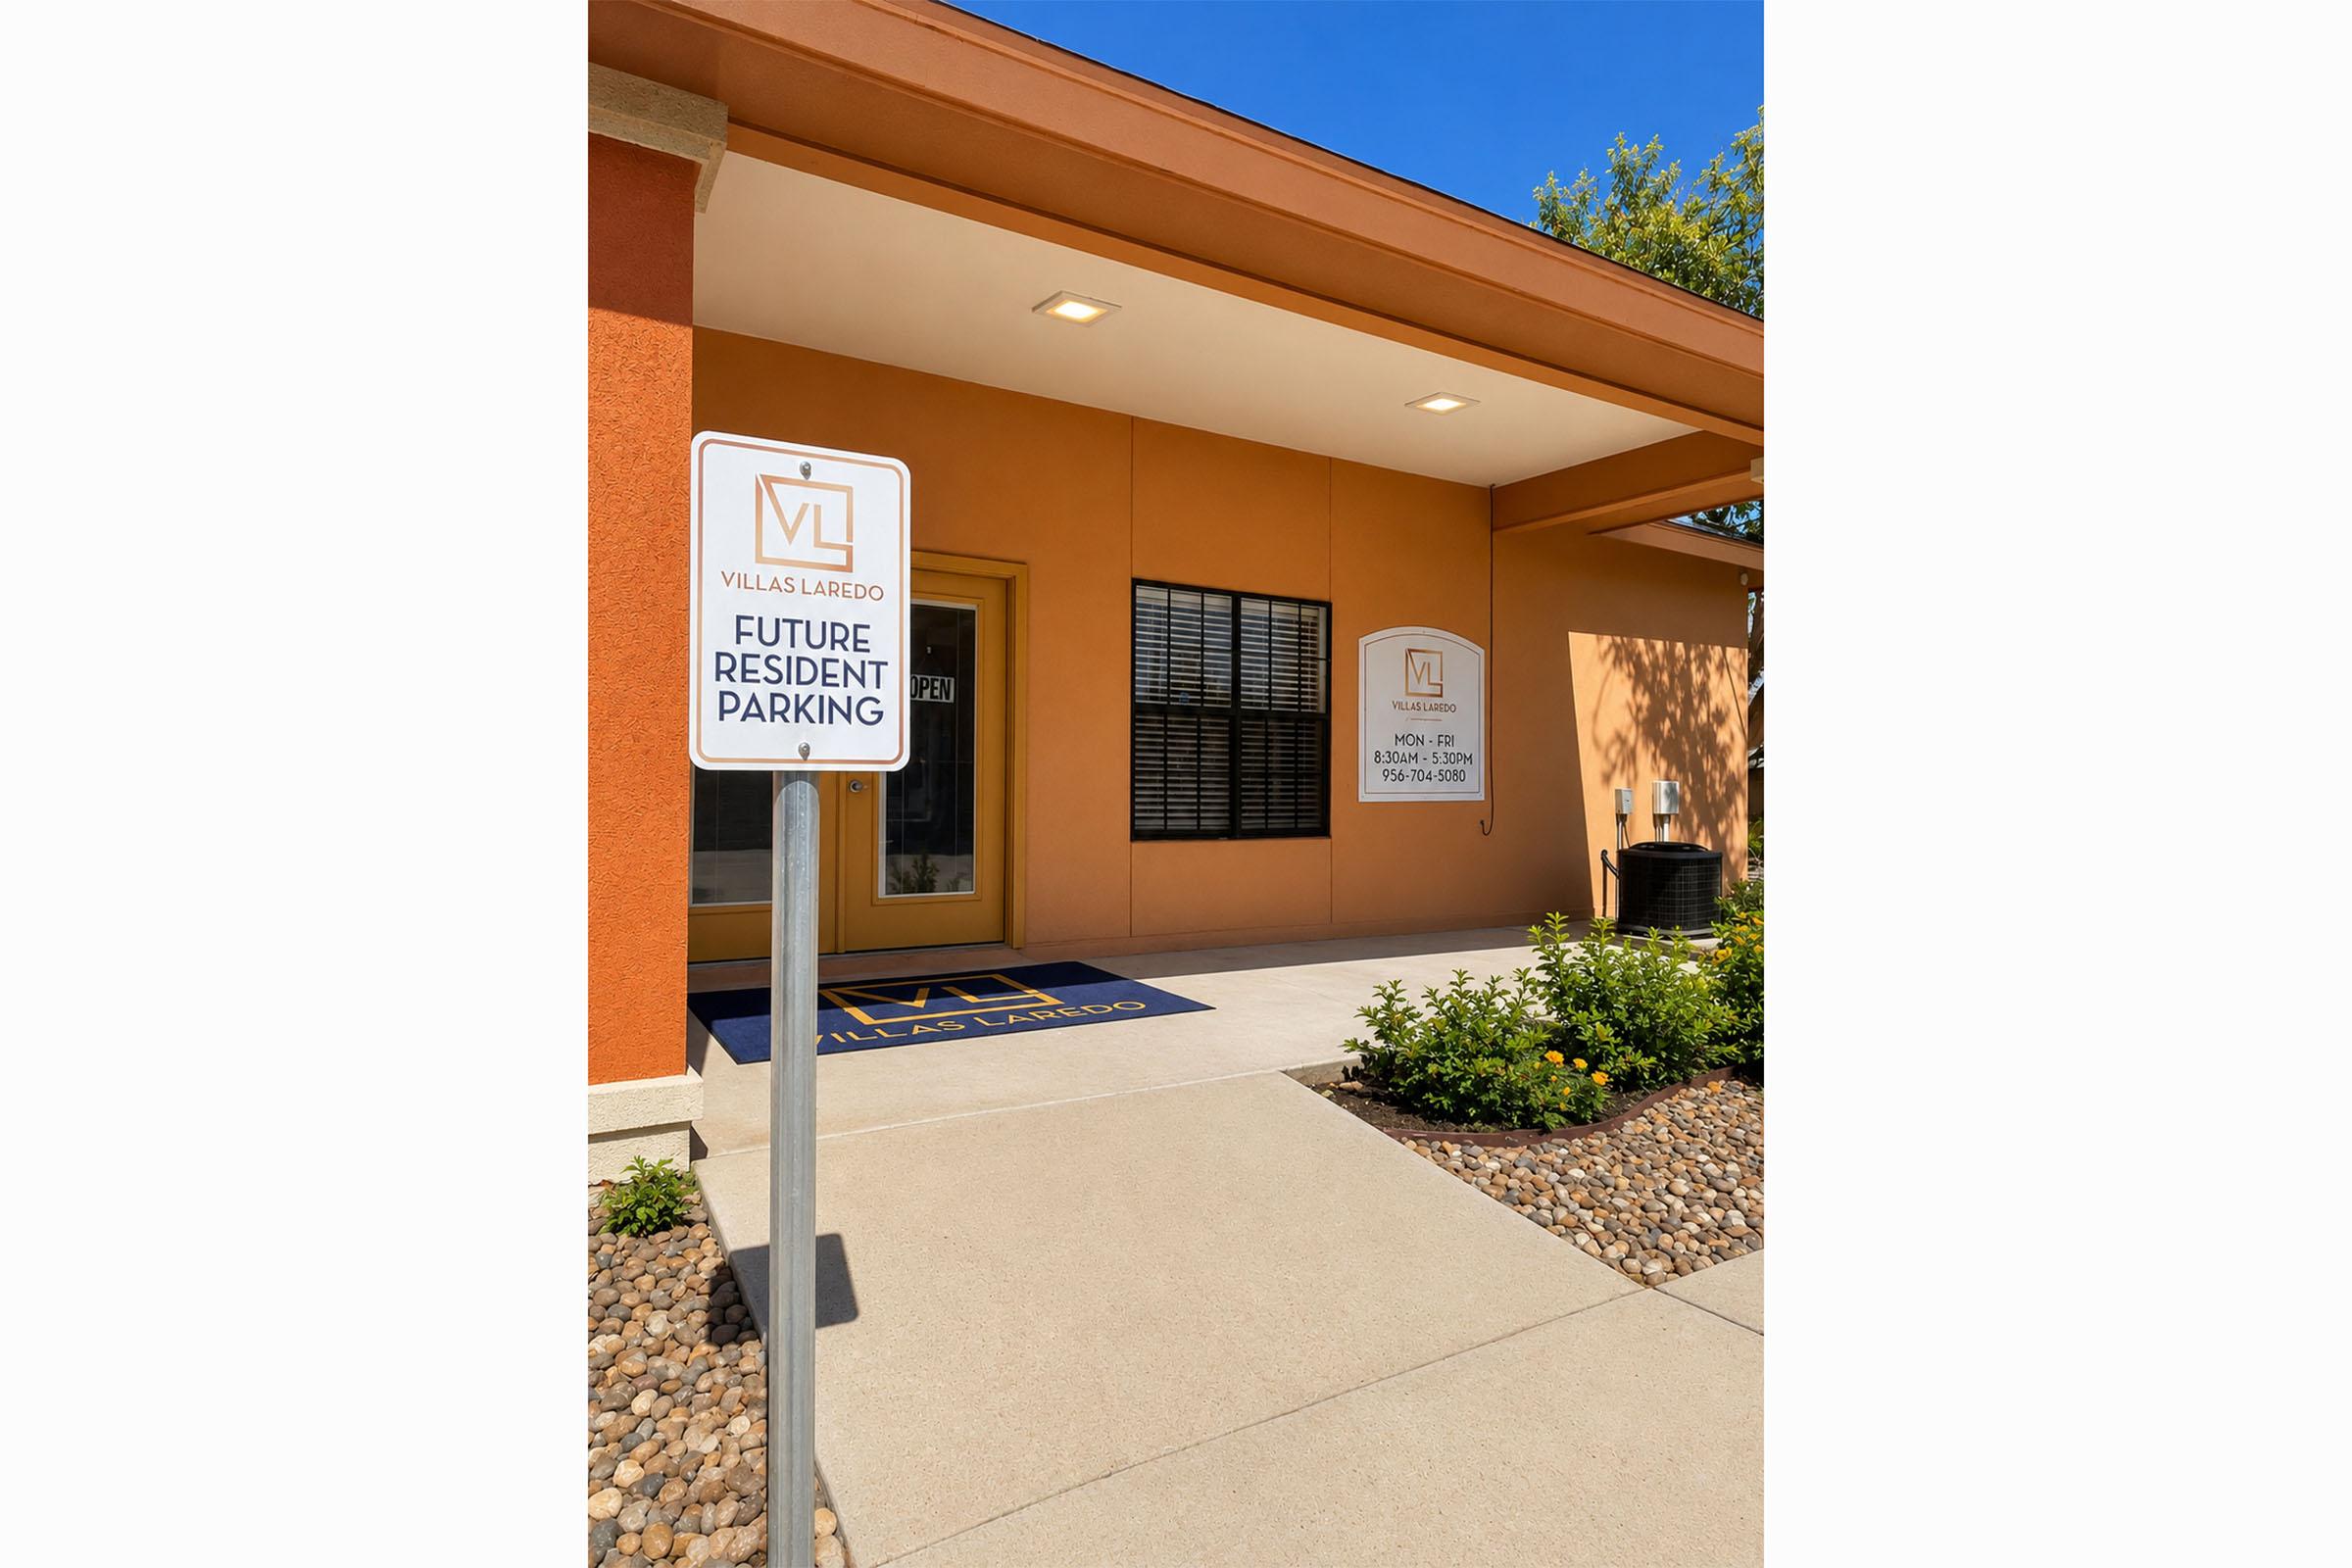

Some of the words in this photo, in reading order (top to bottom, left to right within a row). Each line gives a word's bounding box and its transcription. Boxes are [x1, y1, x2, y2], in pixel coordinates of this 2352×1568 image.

[721, 571, 796, 594] VILLAS
[802, 578, 884, 602] LAREDO
[735, 614, 871, 654] FUTURE
[714, 652, 888, 690] RESIDENT
[910, 676, 951, 700] OPEN
[718, 690, 884, 727] PARKING
[1392, 701, 1421, 711] VILLAS
[1423, 703, 1456, 712] LAREDO
[1395, 733, 1425, 747] MON
[1437, 734, 1454, 747] FRI
[1374, 750, 1418, 764] 8:30AM
[1432, 752, 1473, 765] 5:30PM
[1382, 768, 1466, 782] 956-704-5080
[973, 1001, 1146, 1027] LAREDO
